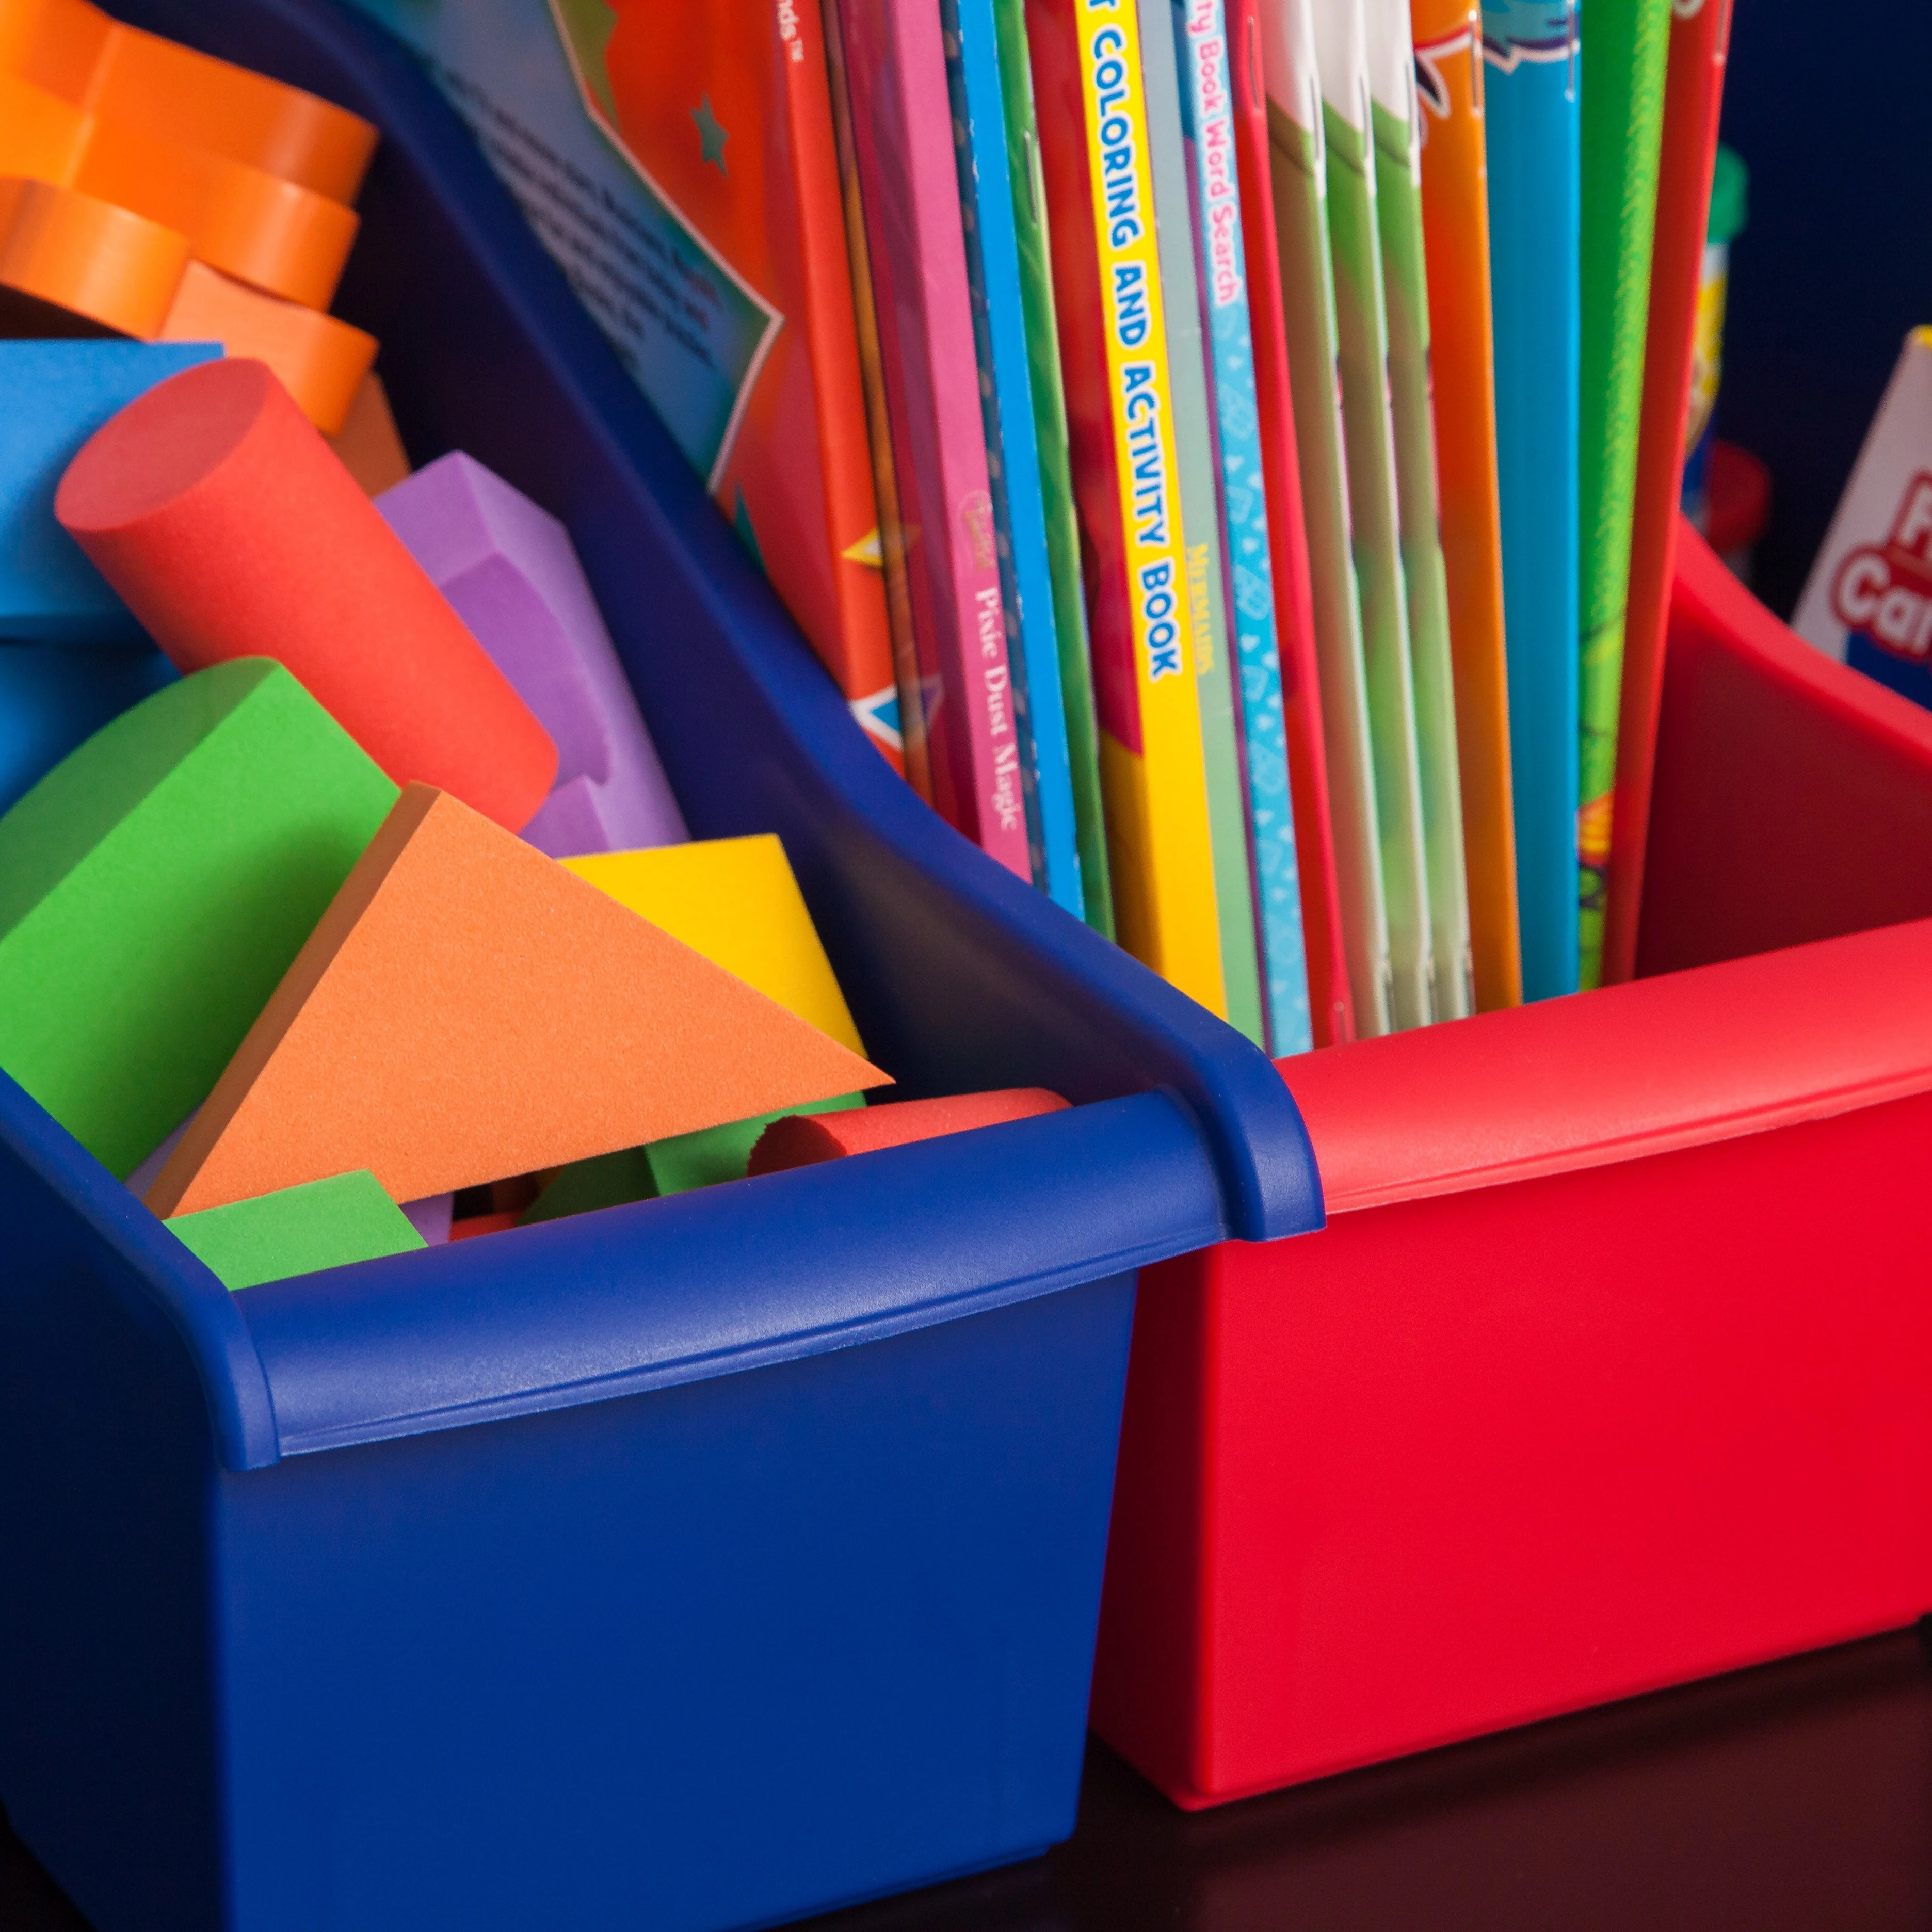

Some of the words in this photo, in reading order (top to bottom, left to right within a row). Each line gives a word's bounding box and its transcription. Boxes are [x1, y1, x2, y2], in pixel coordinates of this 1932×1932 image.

[1200, 40, 1223, 112] Book
[1093, 29, 1139, 247] COLORING
[1206, 120, 1230, 198] Word
[1213, 205, 1239, 302] Search
[1115, 266, 1147, 346] AND
[1124, 366, 1165, 542] ACTIVITY
[975, 588, 1002, 658] Pixie
[1141, 562, 1177, 677] BOOK
[985, 665, 1008, 735] Dust
[991, 742, 1022, 831] Magic
